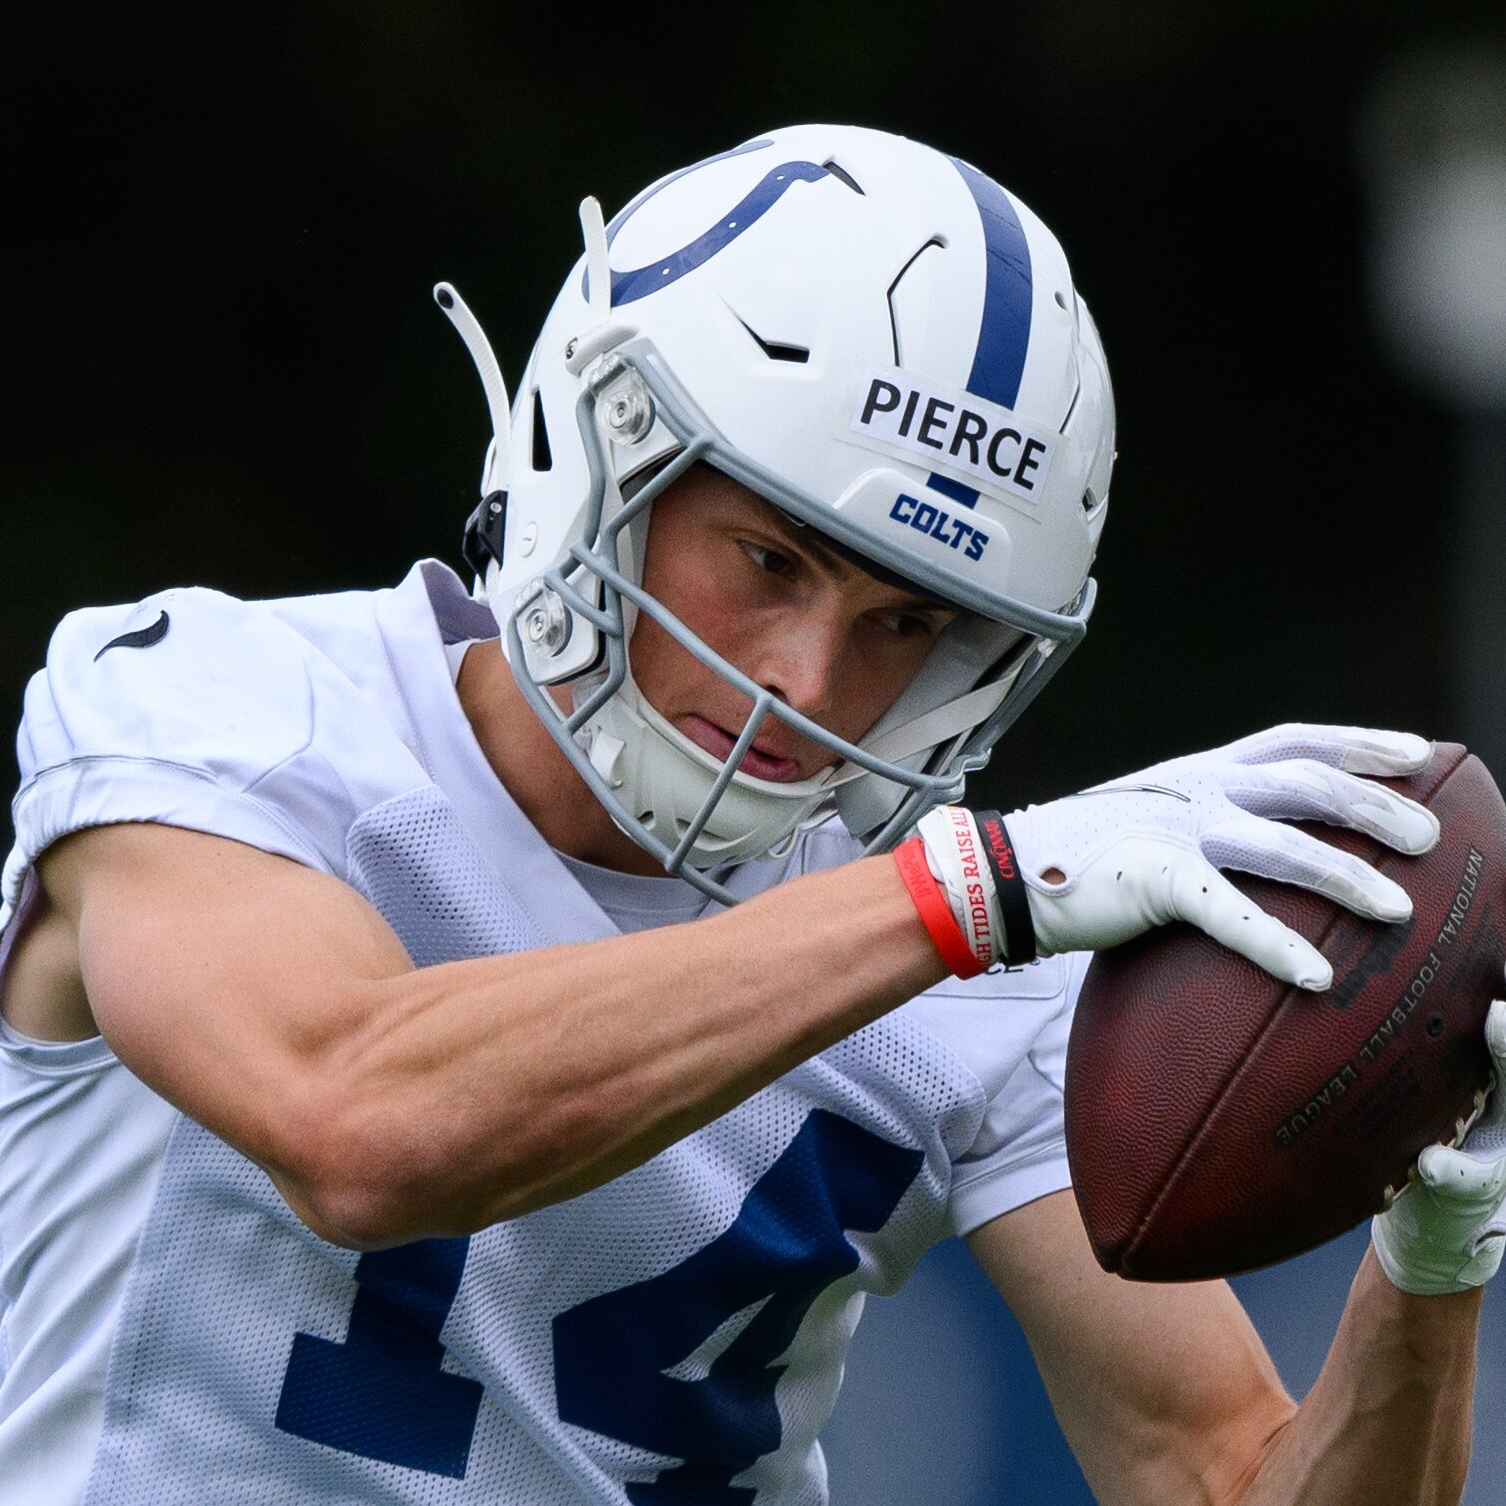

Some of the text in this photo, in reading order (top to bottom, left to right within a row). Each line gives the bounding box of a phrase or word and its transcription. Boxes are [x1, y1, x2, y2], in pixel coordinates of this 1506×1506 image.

[860, 378, 1047, 491] PIERCE
[889, 493, 989, 561] COLTS
[955, 829, 981, 879] RAISE
[967, 883, 990, 941] TIDES
[1276, 848, 1483, 1141] NATIONAL FOOTBALL LEAGUE
